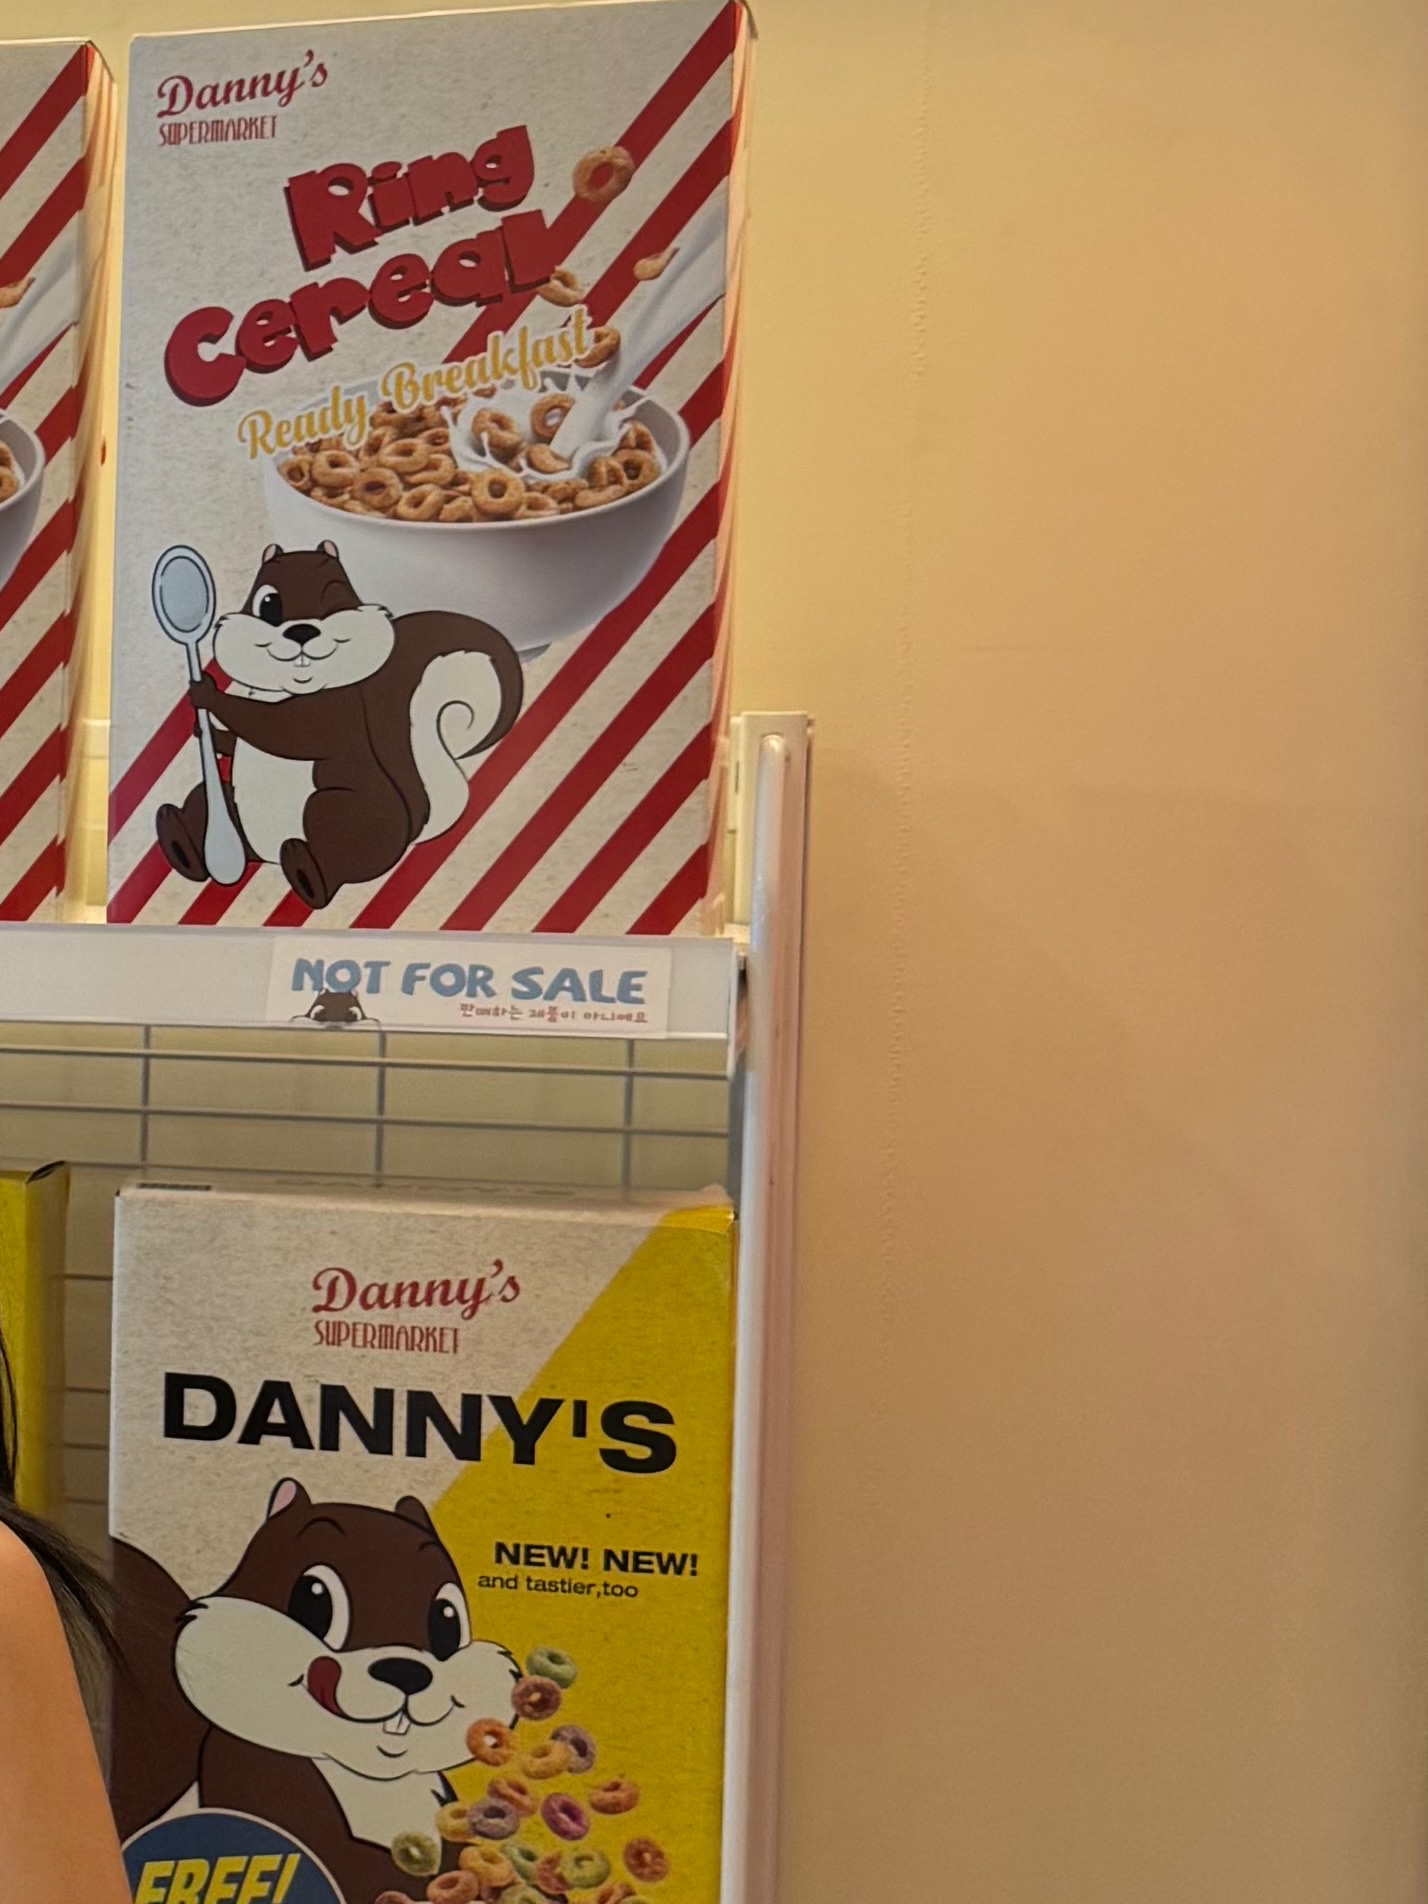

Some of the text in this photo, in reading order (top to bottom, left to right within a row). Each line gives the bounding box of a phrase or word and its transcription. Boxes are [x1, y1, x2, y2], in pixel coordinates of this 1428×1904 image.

[157, 49, 329, 118] Danny's
[159, 115, 277, 146] SUPERMARKET
[283, 125, 534, 271] Ring
[164, 211, 554, 407] Cereal
[238, 310, 594, 460] Ready Breakfast
[292, 958, 647, 1004] NOT FOR SALE
[460, 1003, 523, 1019] 판매하는
[312, 1260, 521, 1319] Danny's
[314, 1318, 459, 1357] SUPERMARKET
[164, 1370, 678, 1473] DANNY'S
[478, 1573, 519, 1592] and
[494, 1539, 699, 1578] NEW! NEW!
